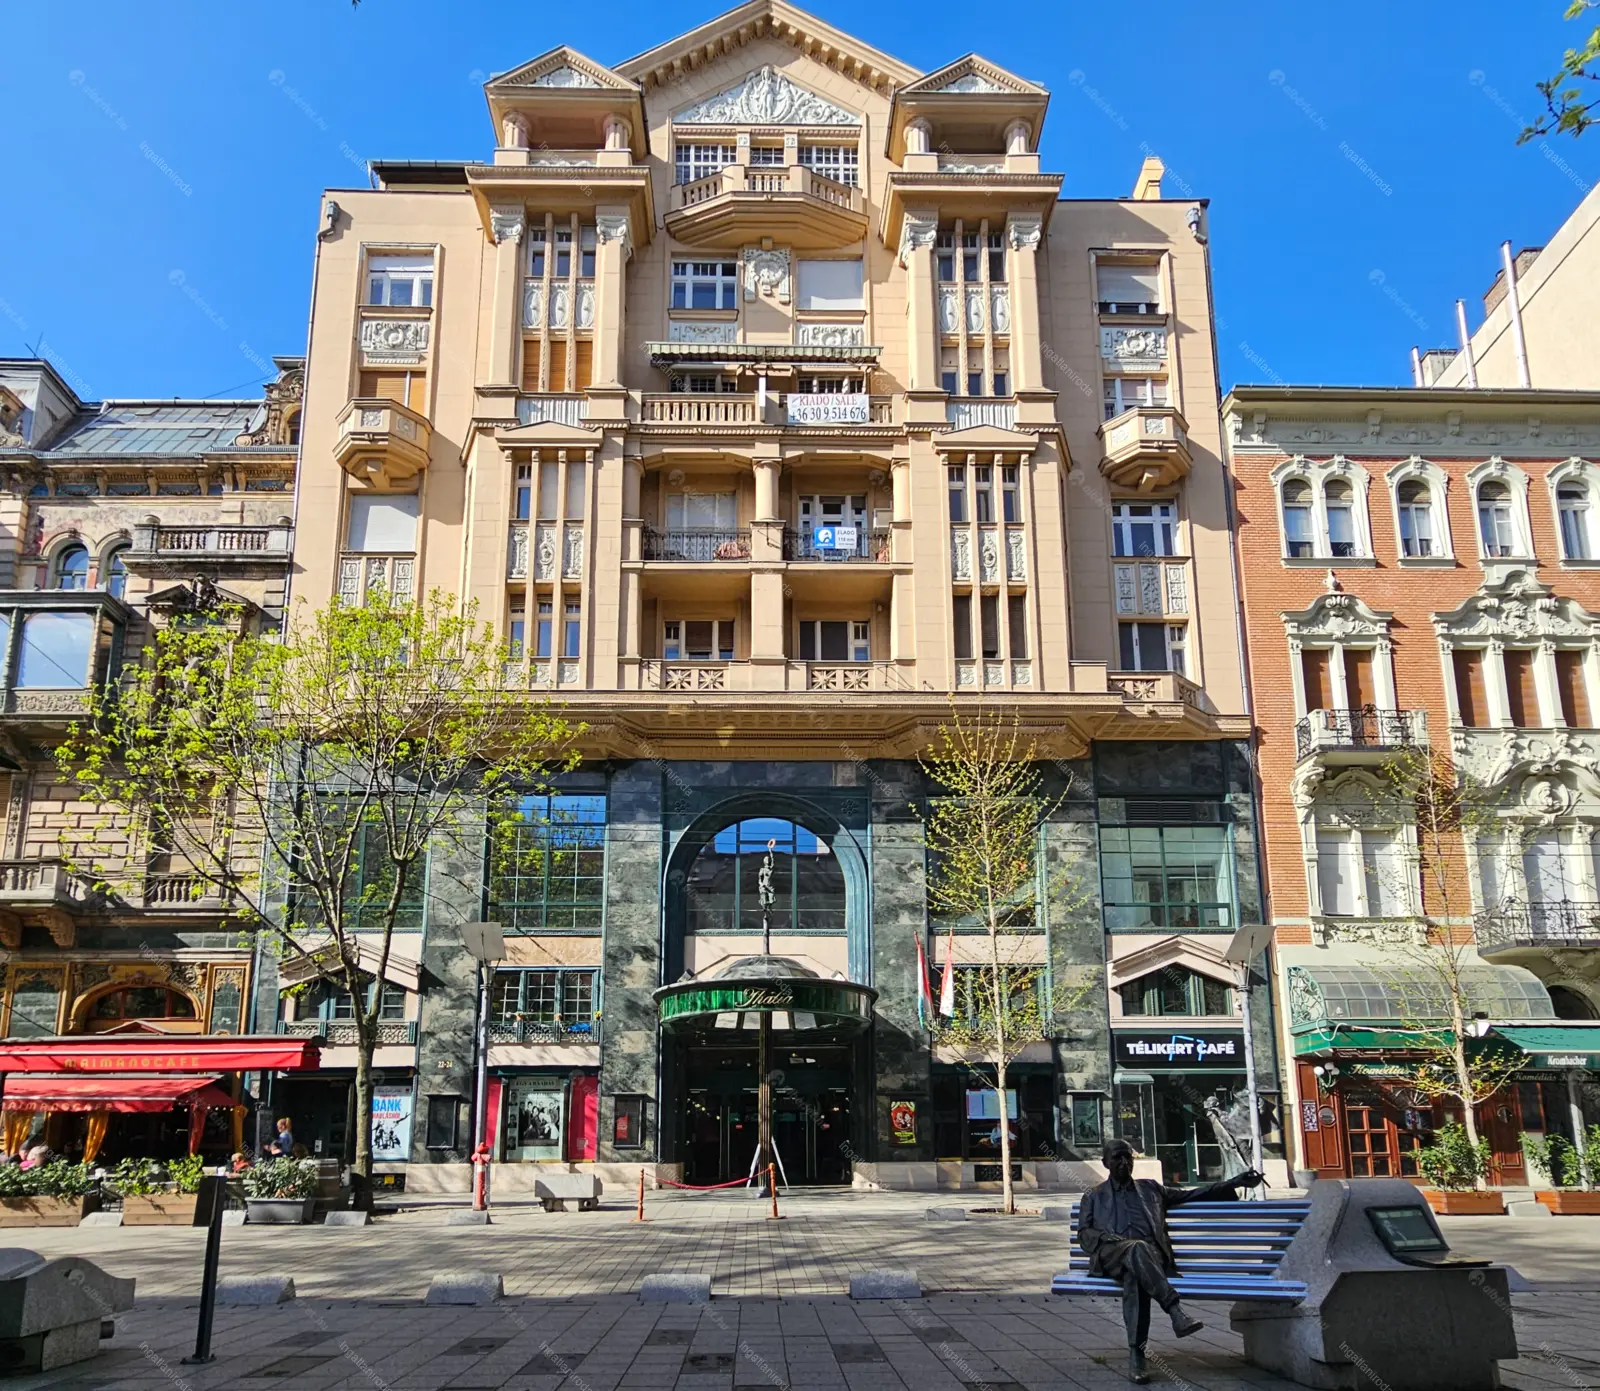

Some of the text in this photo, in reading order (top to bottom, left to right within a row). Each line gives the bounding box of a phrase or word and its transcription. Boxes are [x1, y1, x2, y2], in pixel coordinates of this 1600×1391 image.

[810, 406, 822, 421] 30
[823, 406, 830, 421] 9
[831, 406, 848, 420] 514
[849, 406, 867, 420] 676
[735, 986, 794, 1008] Thália
[1126, 1039, 1236, 1056] TÉLIKERT CAFÉ
[1547, 1055, 1588, 1066] Krombacher
[374, 1098, 402, 1112] BANK
